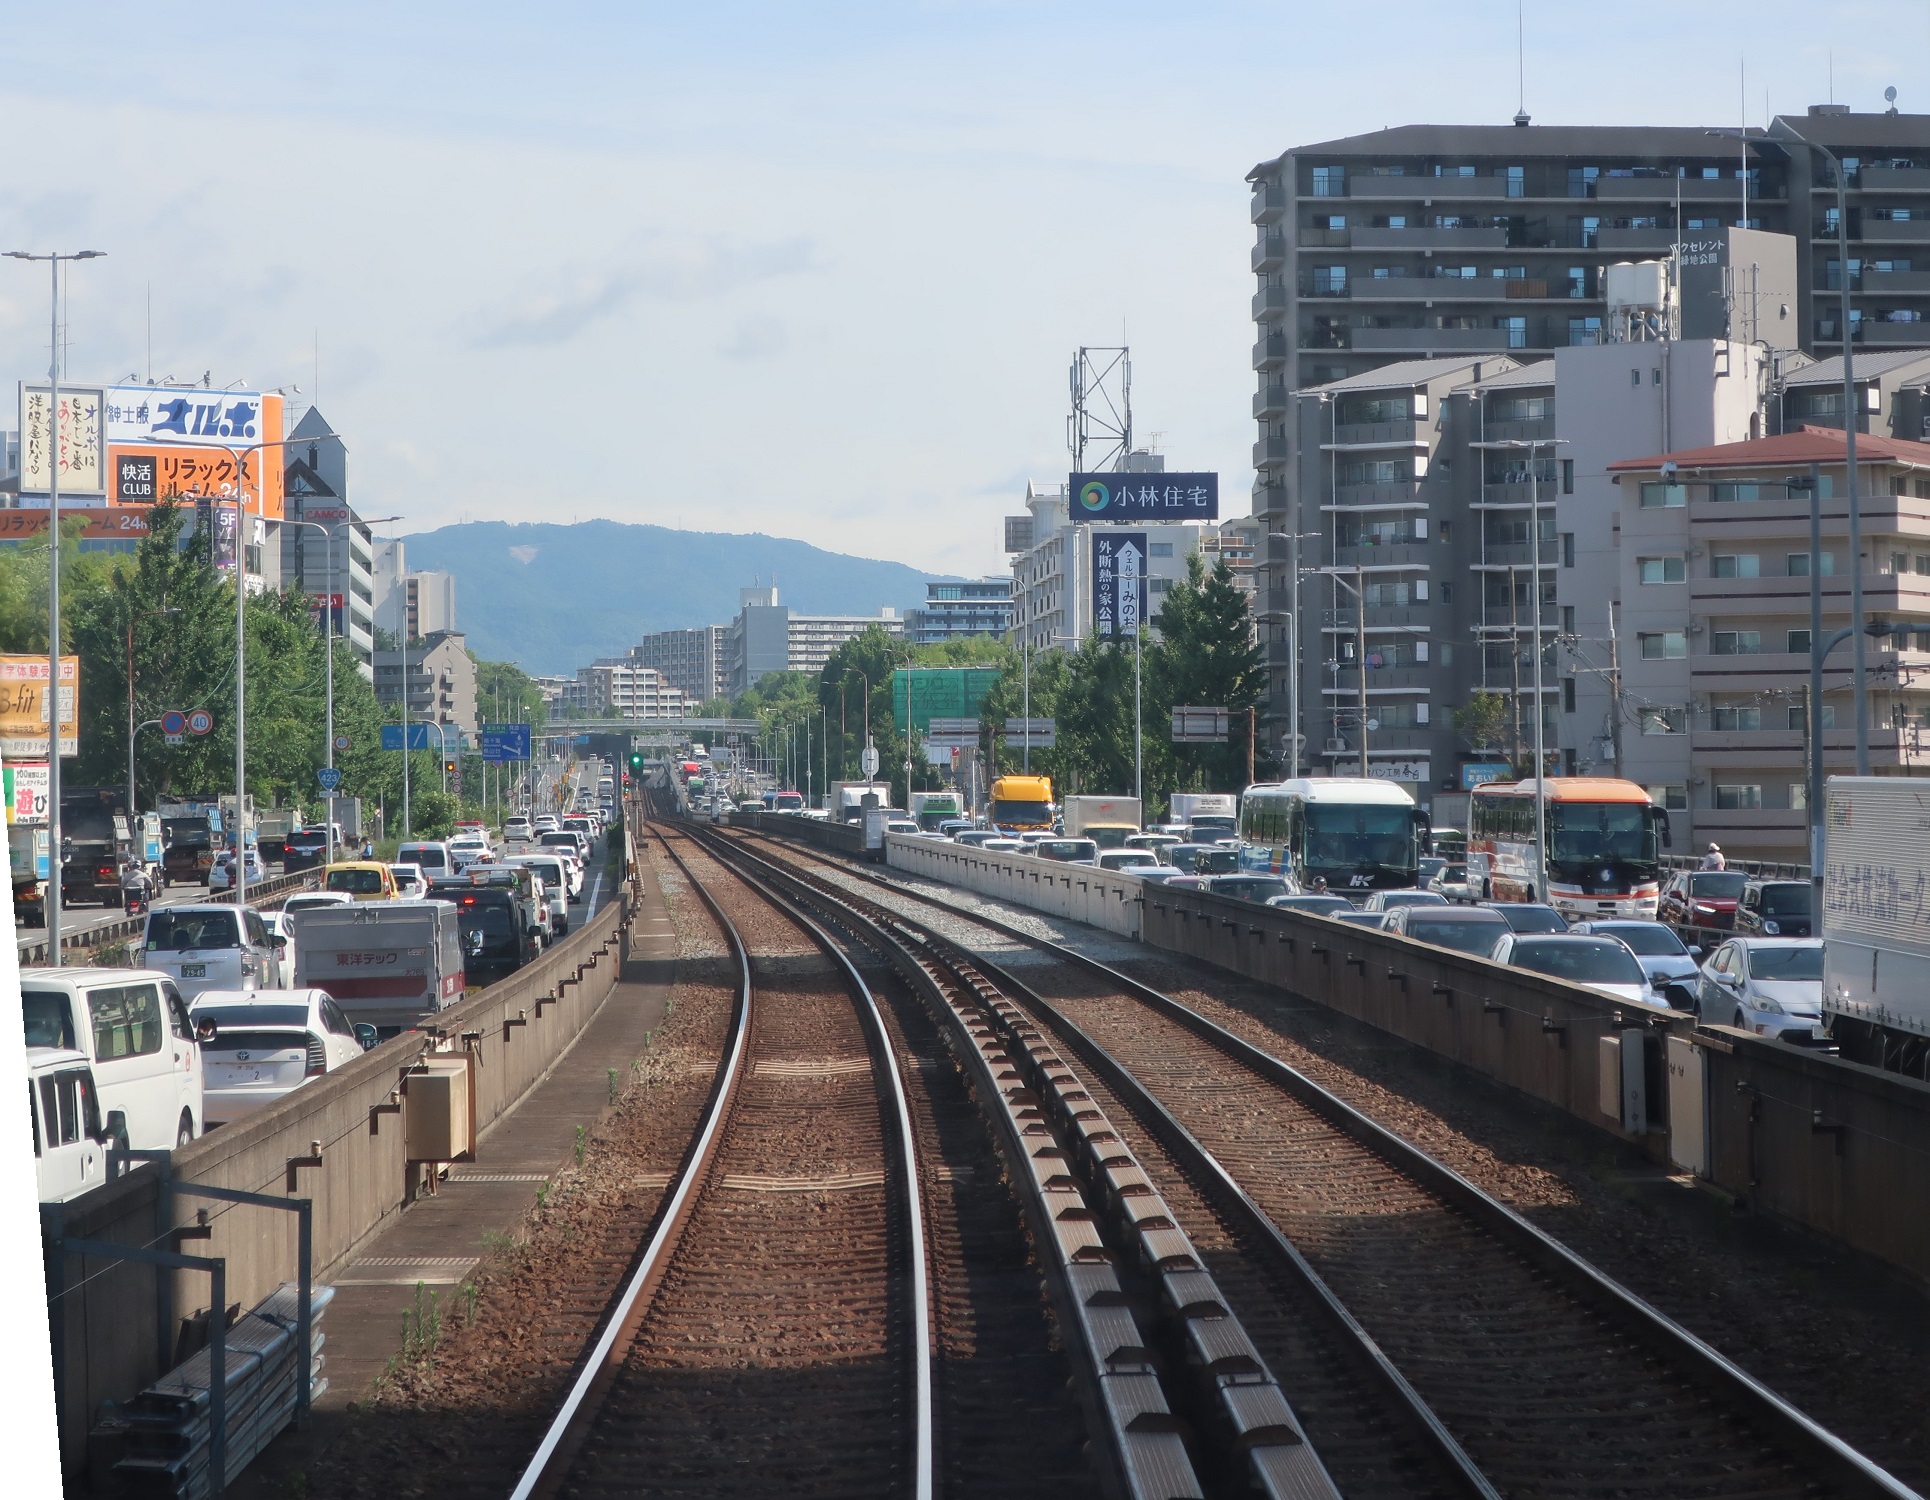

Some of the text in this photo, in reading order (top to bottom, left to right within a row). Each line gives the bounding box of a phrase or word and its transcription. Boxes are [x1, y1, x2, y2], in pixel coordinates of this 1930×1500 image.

[1674, 240, 1725, 253] クセレント
[108, 405, 150, 424] 紳士服
[122, 464, 151, 481] 快活
[164, 458, 251, 480] リラックス
[122, 484, 151, 495] CLUB
[1114, 485, 1209, 507] 小林住宅
[220, 513, 236, 526] 5F
[305, 510, 348, 520] CAMCO
[120, 515, 147, 530] 24h
[1098, 540, 1113, 635] 外断熱の家公開
[0, 665, 73, 678] 学体験受中
[194, 717, 207, 728] 40
[337, 739, 347, 747] 40
[16, 789, 48, 815] 遊び
[336, 952, 397, 966] 東洋テック
[186, 969, 206, 977] 29-45
